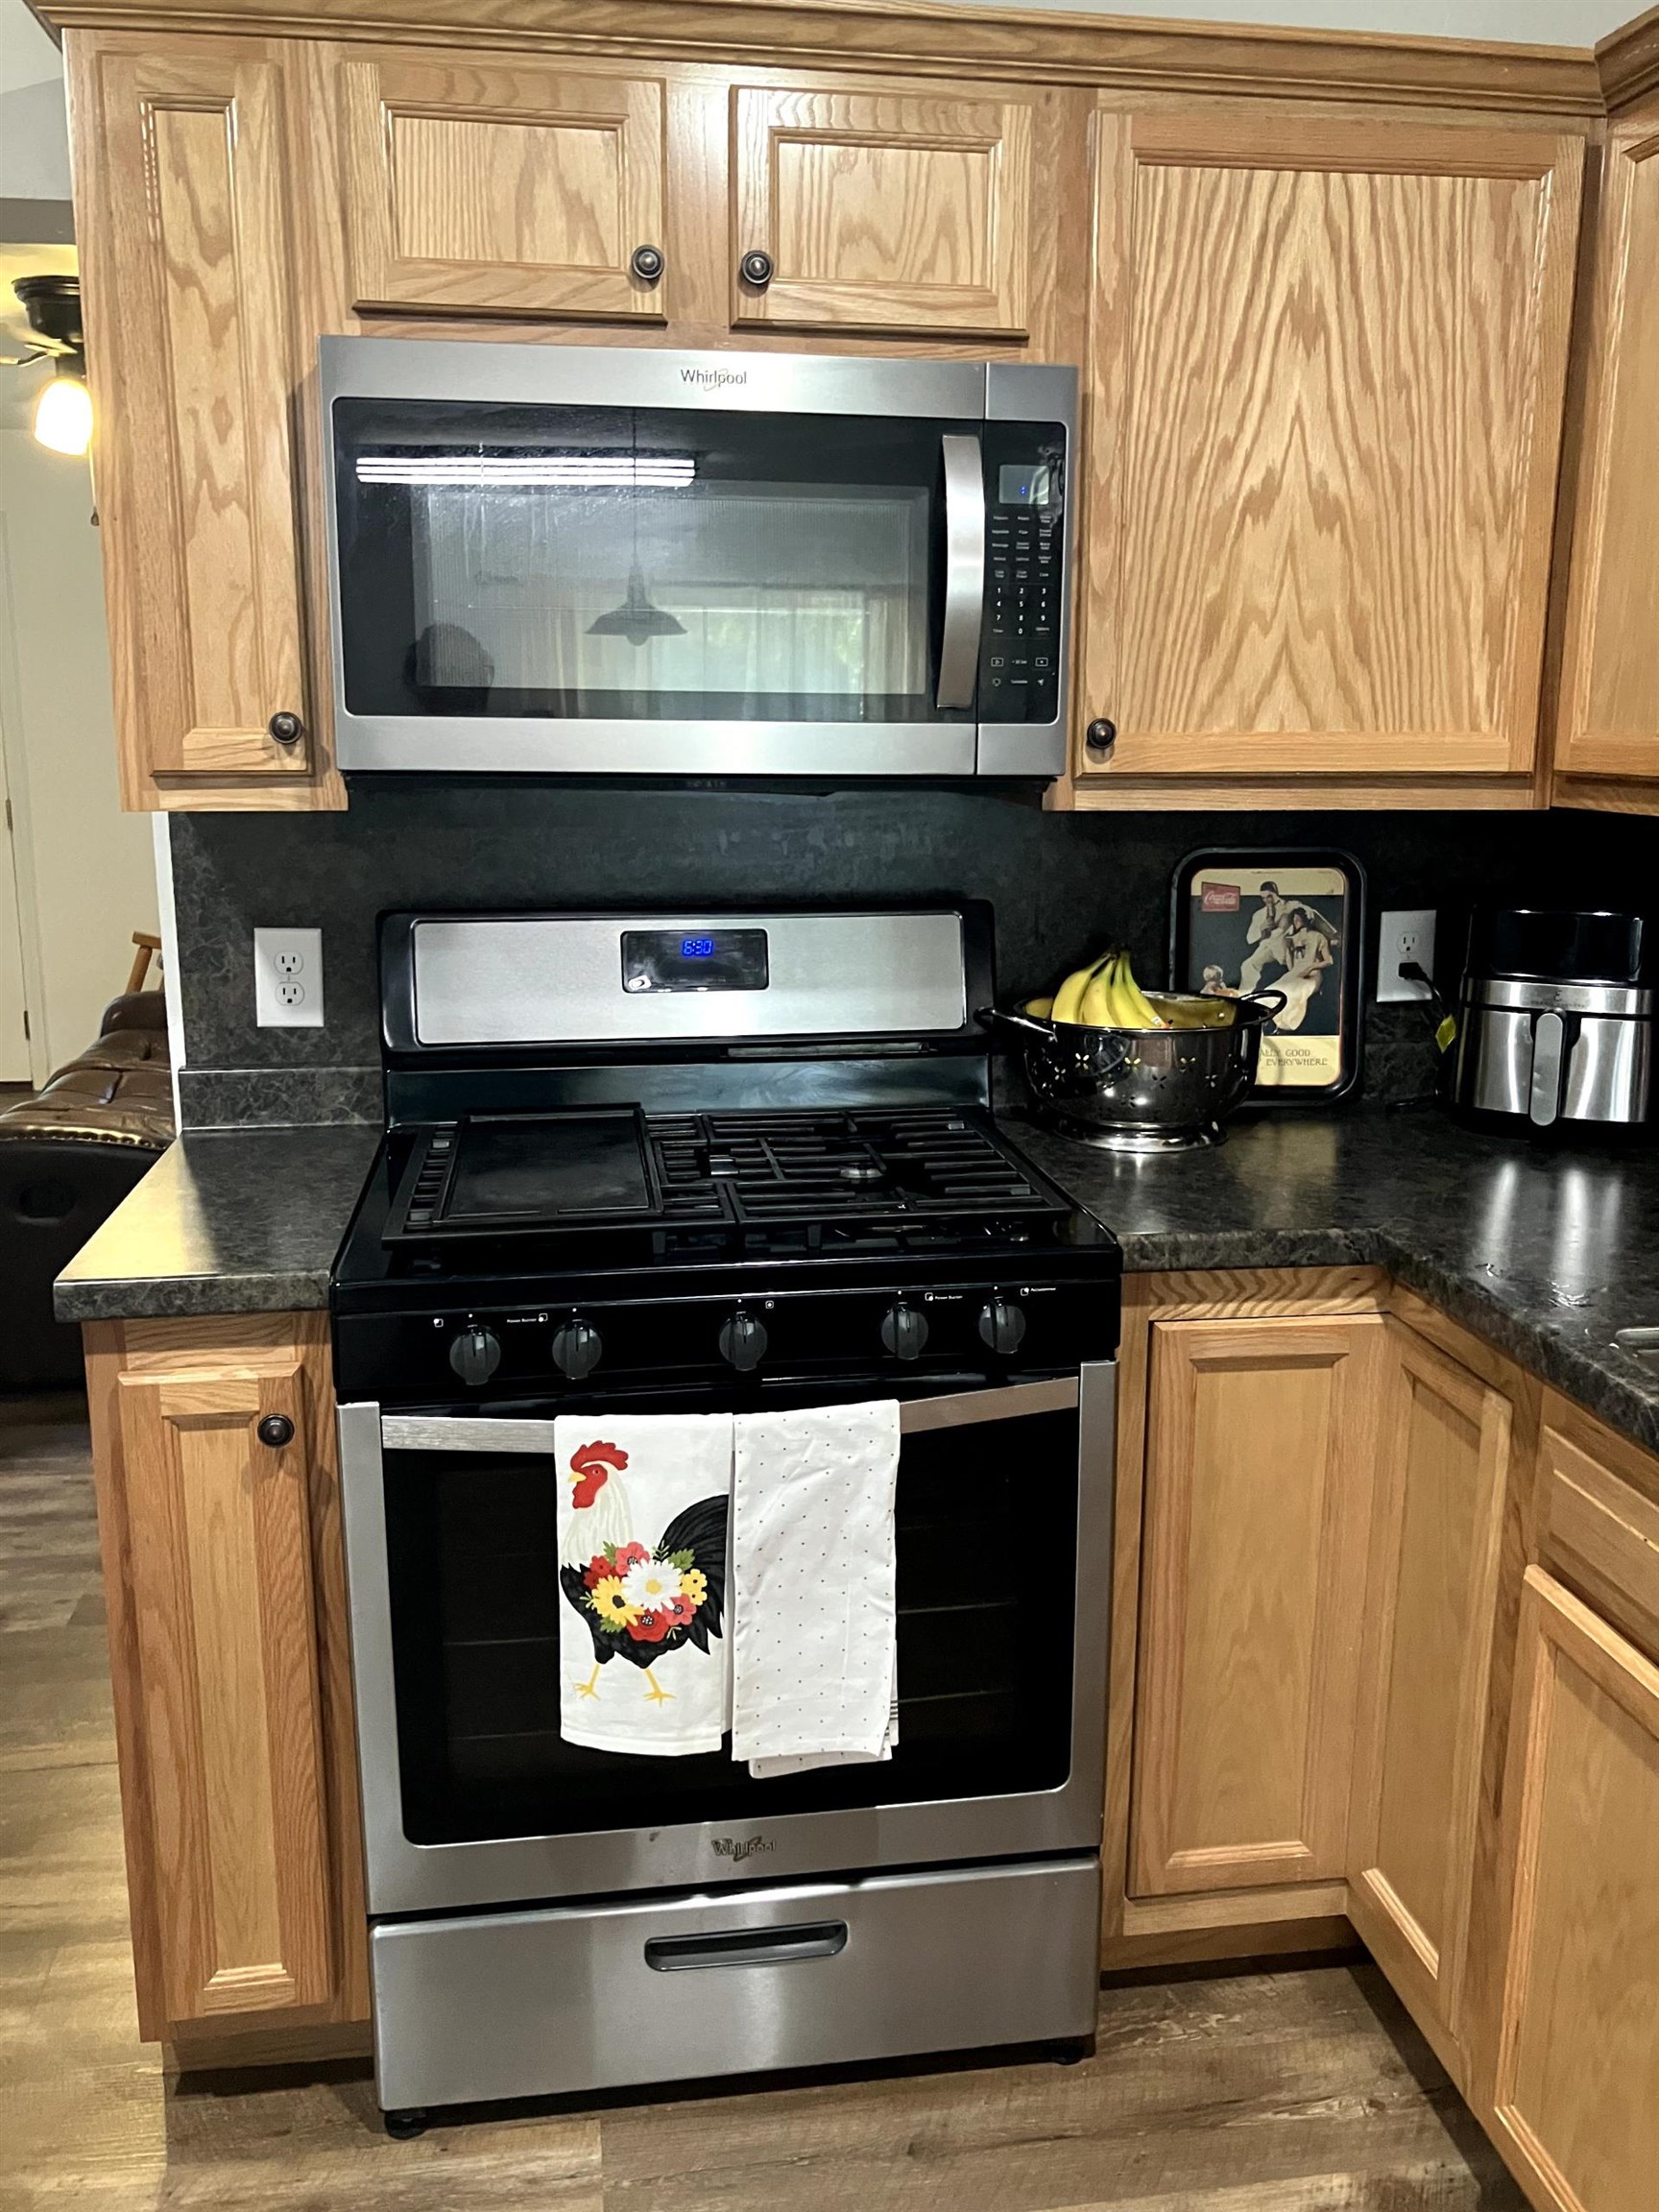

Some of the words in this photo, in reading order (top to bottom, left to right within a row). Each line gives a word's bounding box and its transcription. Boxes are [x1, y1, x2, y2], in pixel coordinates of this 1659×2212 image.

[680, 369, 747, 389] Whirlpool
[683, 940, 712, 954] 6:30
[1285, 1048, 1311, 1057] GOOD
[1265, 1058, 1328, 1067] EVERYWHERE
[711, 1837, 777, 1859] Whirlpool
